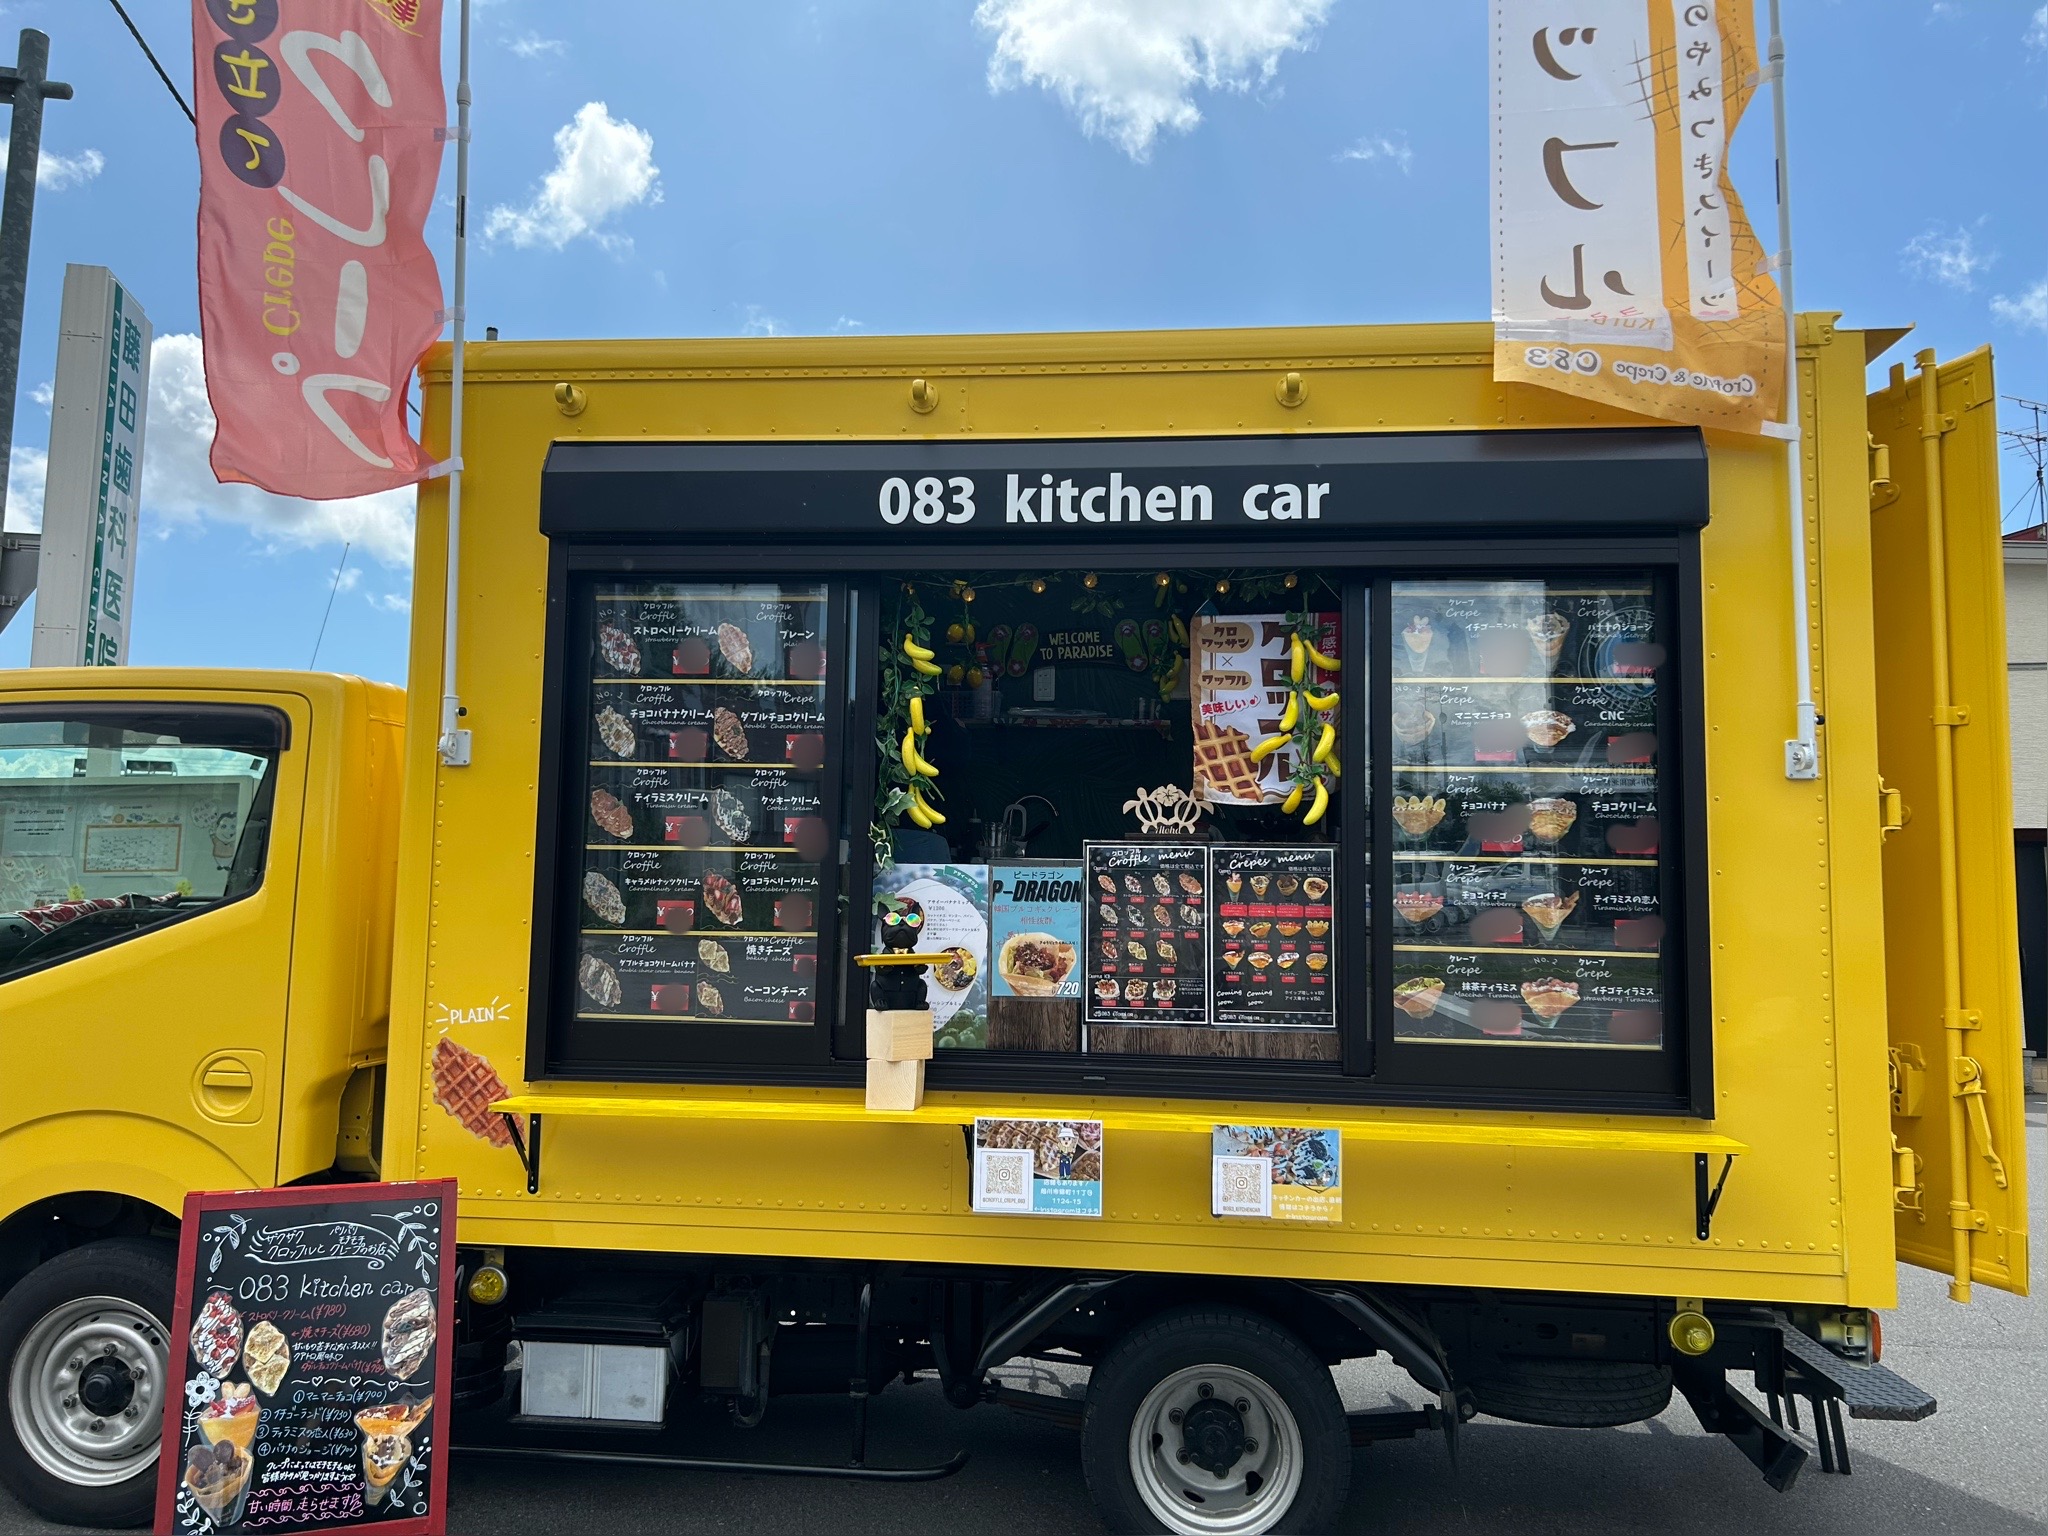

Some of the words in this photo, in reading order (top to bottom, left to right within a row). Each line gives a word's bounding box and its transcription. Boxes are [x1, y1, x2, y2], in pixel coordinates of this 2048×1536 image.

[107, 308, 122, 410] FUJITA
[95, 431, 113, 543] DENTAL
[878, 475, 976, 525] 083
[1005, 472, 1213, 524] kitchen
[1242, 481, 1330, 521] car
[643, 602, 675, 610] クロッフル
[760, 602, 792, 611] クロッフル
[1448, 599, 1475, 607] クレープ
[1579, 599, 1607, 607] クレープ
[639, 611, 678, 622] Croffle
[755, 611, 795, 622] Croffle
[1445, 608, 1481, 618] Crepe
[1577, 608, 1613, 618] Crepe
[633, 625, 719, 637] ストロベリークリーム
[779, 629, 815, 640] プレーン
[1213, 626, 1238, 637] クロ
[1048, 631, 1100, 646] WELCOME
[1201, 638, 1250, 649] ワッサン
[1040, 647, 1053, 660] TO
[1057, 645, 1113, 660] PARADISE
[1201, 674, 1250, 686] ワッフル
[639, 685, 672, 693] クロッフル
[757, 689, 790, 698] クロッフル
[1441, 685, 1469, 693] クレープ
[1574, 685, 1602, 694] クレープ
[635, 693, 675, 705] Croffle
[783, 694, 816, 704] Crepe
[1439, 695, 1475, 706] Crepe
[1571, 695, 1608, 707] Crepe
[1201, 698, 1247, 716] 美味しい
[629, 708, 715, 720] チョコバナナクリーム
[740, 711, 826, 723] ダブルチョコクリーム
[1454, 712, 1512, 721] マニマニチョコ
[1599, 710, 1625, 722] CNC
[636, 768, 668, 776] クロッフル
[754, 769, 787, 777] クロッフル
[632, 777, 671, 788] Croffle
[750, 777, 790, 789] Croffle
[1448, 775, 1475, 783] クレープ
[1582, 775, 1609, 784] クレープ
[1445, 784, 1482, 795] Crepe
[1579, 785, 1616, 796] Crepe
[634, 792, 709, 803] ティラミスクリーム
[761, 795, 821, 806] クッキークリーム
[1461, 801, 1508, 811] チョコバナナ
[1591, 801, 1658, 813] チョコクリーム
[627, 851, 660, 859] クロッフル
[744, 852, 776, 860] クロッフル
[1108, 853, 1151, 868] Croffle
[1158, 850, 1195, 861] menu
[622, 860, 663, 872] Croffle
[739, 861, 779, 872] Croffle
[1229, 857, 1272, 870] Crepes
[1277, 852, 1316, 864] menu
[1449, 863, 1477, 872] クレープ
[1581, 867, 1609, 876] クレープ
[741, 876, 819, 886] ショコラベリークリーム
[1445, 873, 1483, 884] Crepe
[1578, 876, 1615, 887] Crepe
[992, 879, 1083, 903] P-DRAGON
[1461, 891, 1508, 900] チョコイチゴ
[1593, 894, 1660, 905] ティラミスの恋人
[621, 934, 654, 943] クロッフル
[769, 936, 806, 947] Croffle
[617, 943, 658, 955] Croffle
[745, 944, 791, 956] 焼きチーズ
[1449, 955, 1477, 963] クレープ
[1578, 958, 1606, 967] クレープ
[1446, 964, 1483, 975] Crepe
[1575, 967, 1613, 978] Crepe
[743, 985, 810, 998] ベーコンチーズ
[1056, 980, 1080, 996] 720
[1461, 981, 1518, 992] 抹茶ティラミス
[1591, 985, 1655, 997] イチゴティラミス
[1216, 988, 1243, 997] Coming
[1246, 989, 1273, 998] Coming
[450, 1006, 495, 1025] PLAIN
[329, 1224, 359, 1236] パリパリ
[266, 1229, 305, 1245] ザクザク
[338, 1235, 366, 1245] モチモチ
[267, 1243, 326, 1260] クロッフルと
[329, 1241, 388, 1257] クレープのお店
[239, 1274, 290, 1302] 083
[299, 1273, 374, 1299] kitchen
[379, 1280, 415, 1297] car
